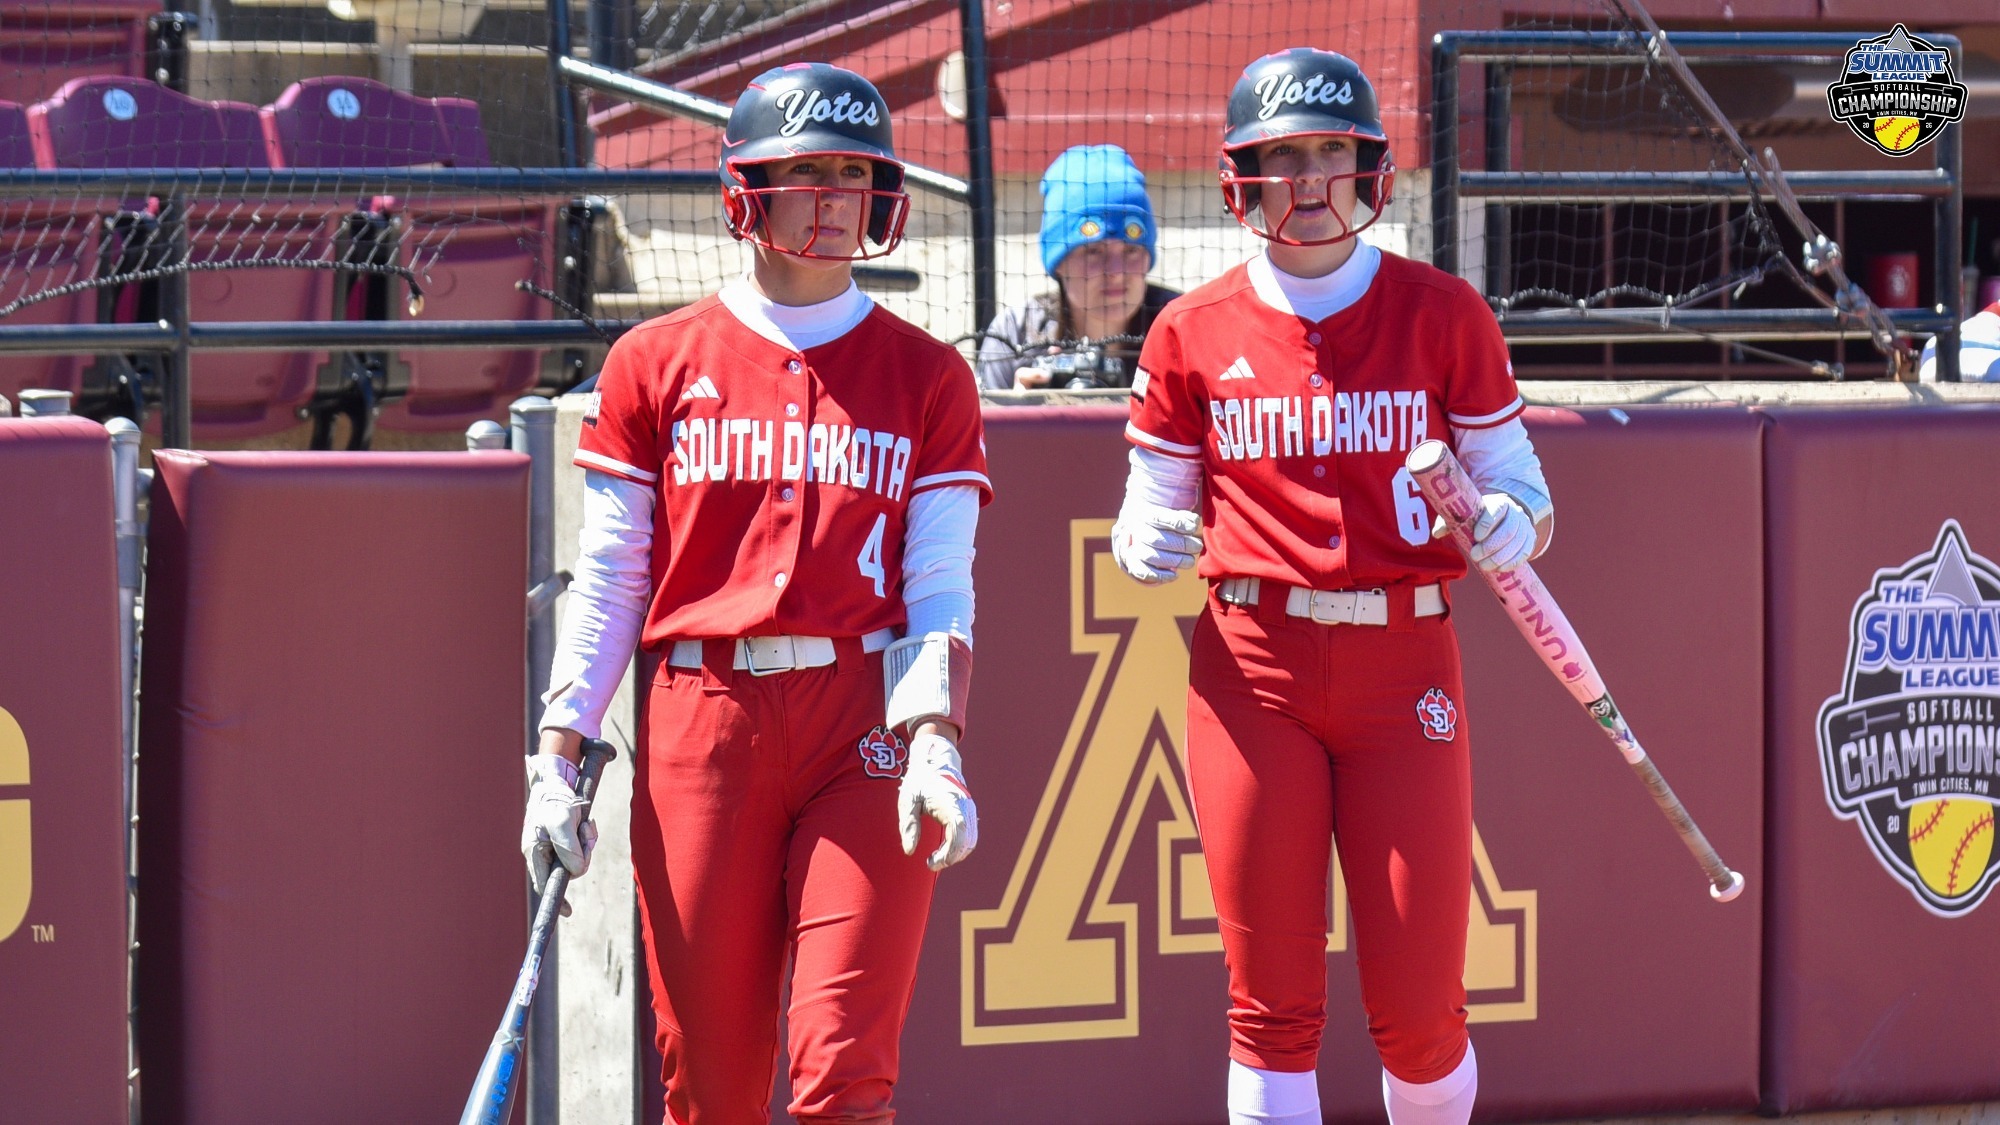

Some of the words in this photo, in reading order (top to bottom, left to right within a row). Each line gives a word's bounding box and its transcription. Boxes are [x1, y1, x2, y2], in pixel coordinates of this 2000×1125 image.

[776, 88, 880, 137] Yotes
[1254, 74, 1354, 121] Yotes
[1210, 395, 1304, 461] SOUTH
[1312, 389, 1428, 457] DAKOTA
[672, 417, 774, 487] SOUTH
[782, 421, 912, 503] DAKOTA
[1391, 465, 1431, 547] 6
[856, 512, 887, 599] 4
[1882, 586, 1925, 602] THE
[1862, 611, 2000, 662] SUMM
[1905, 667, 2000, 688] LEAGUE
[1906, 699, 1994, 725] SOFTBALL
[1912, 778, 1938, 797] TWIN
[1974, 778, 1990, 795] MN
[1887, 815, 1900, 834] 20
[31, 924, 55, 943] TM
